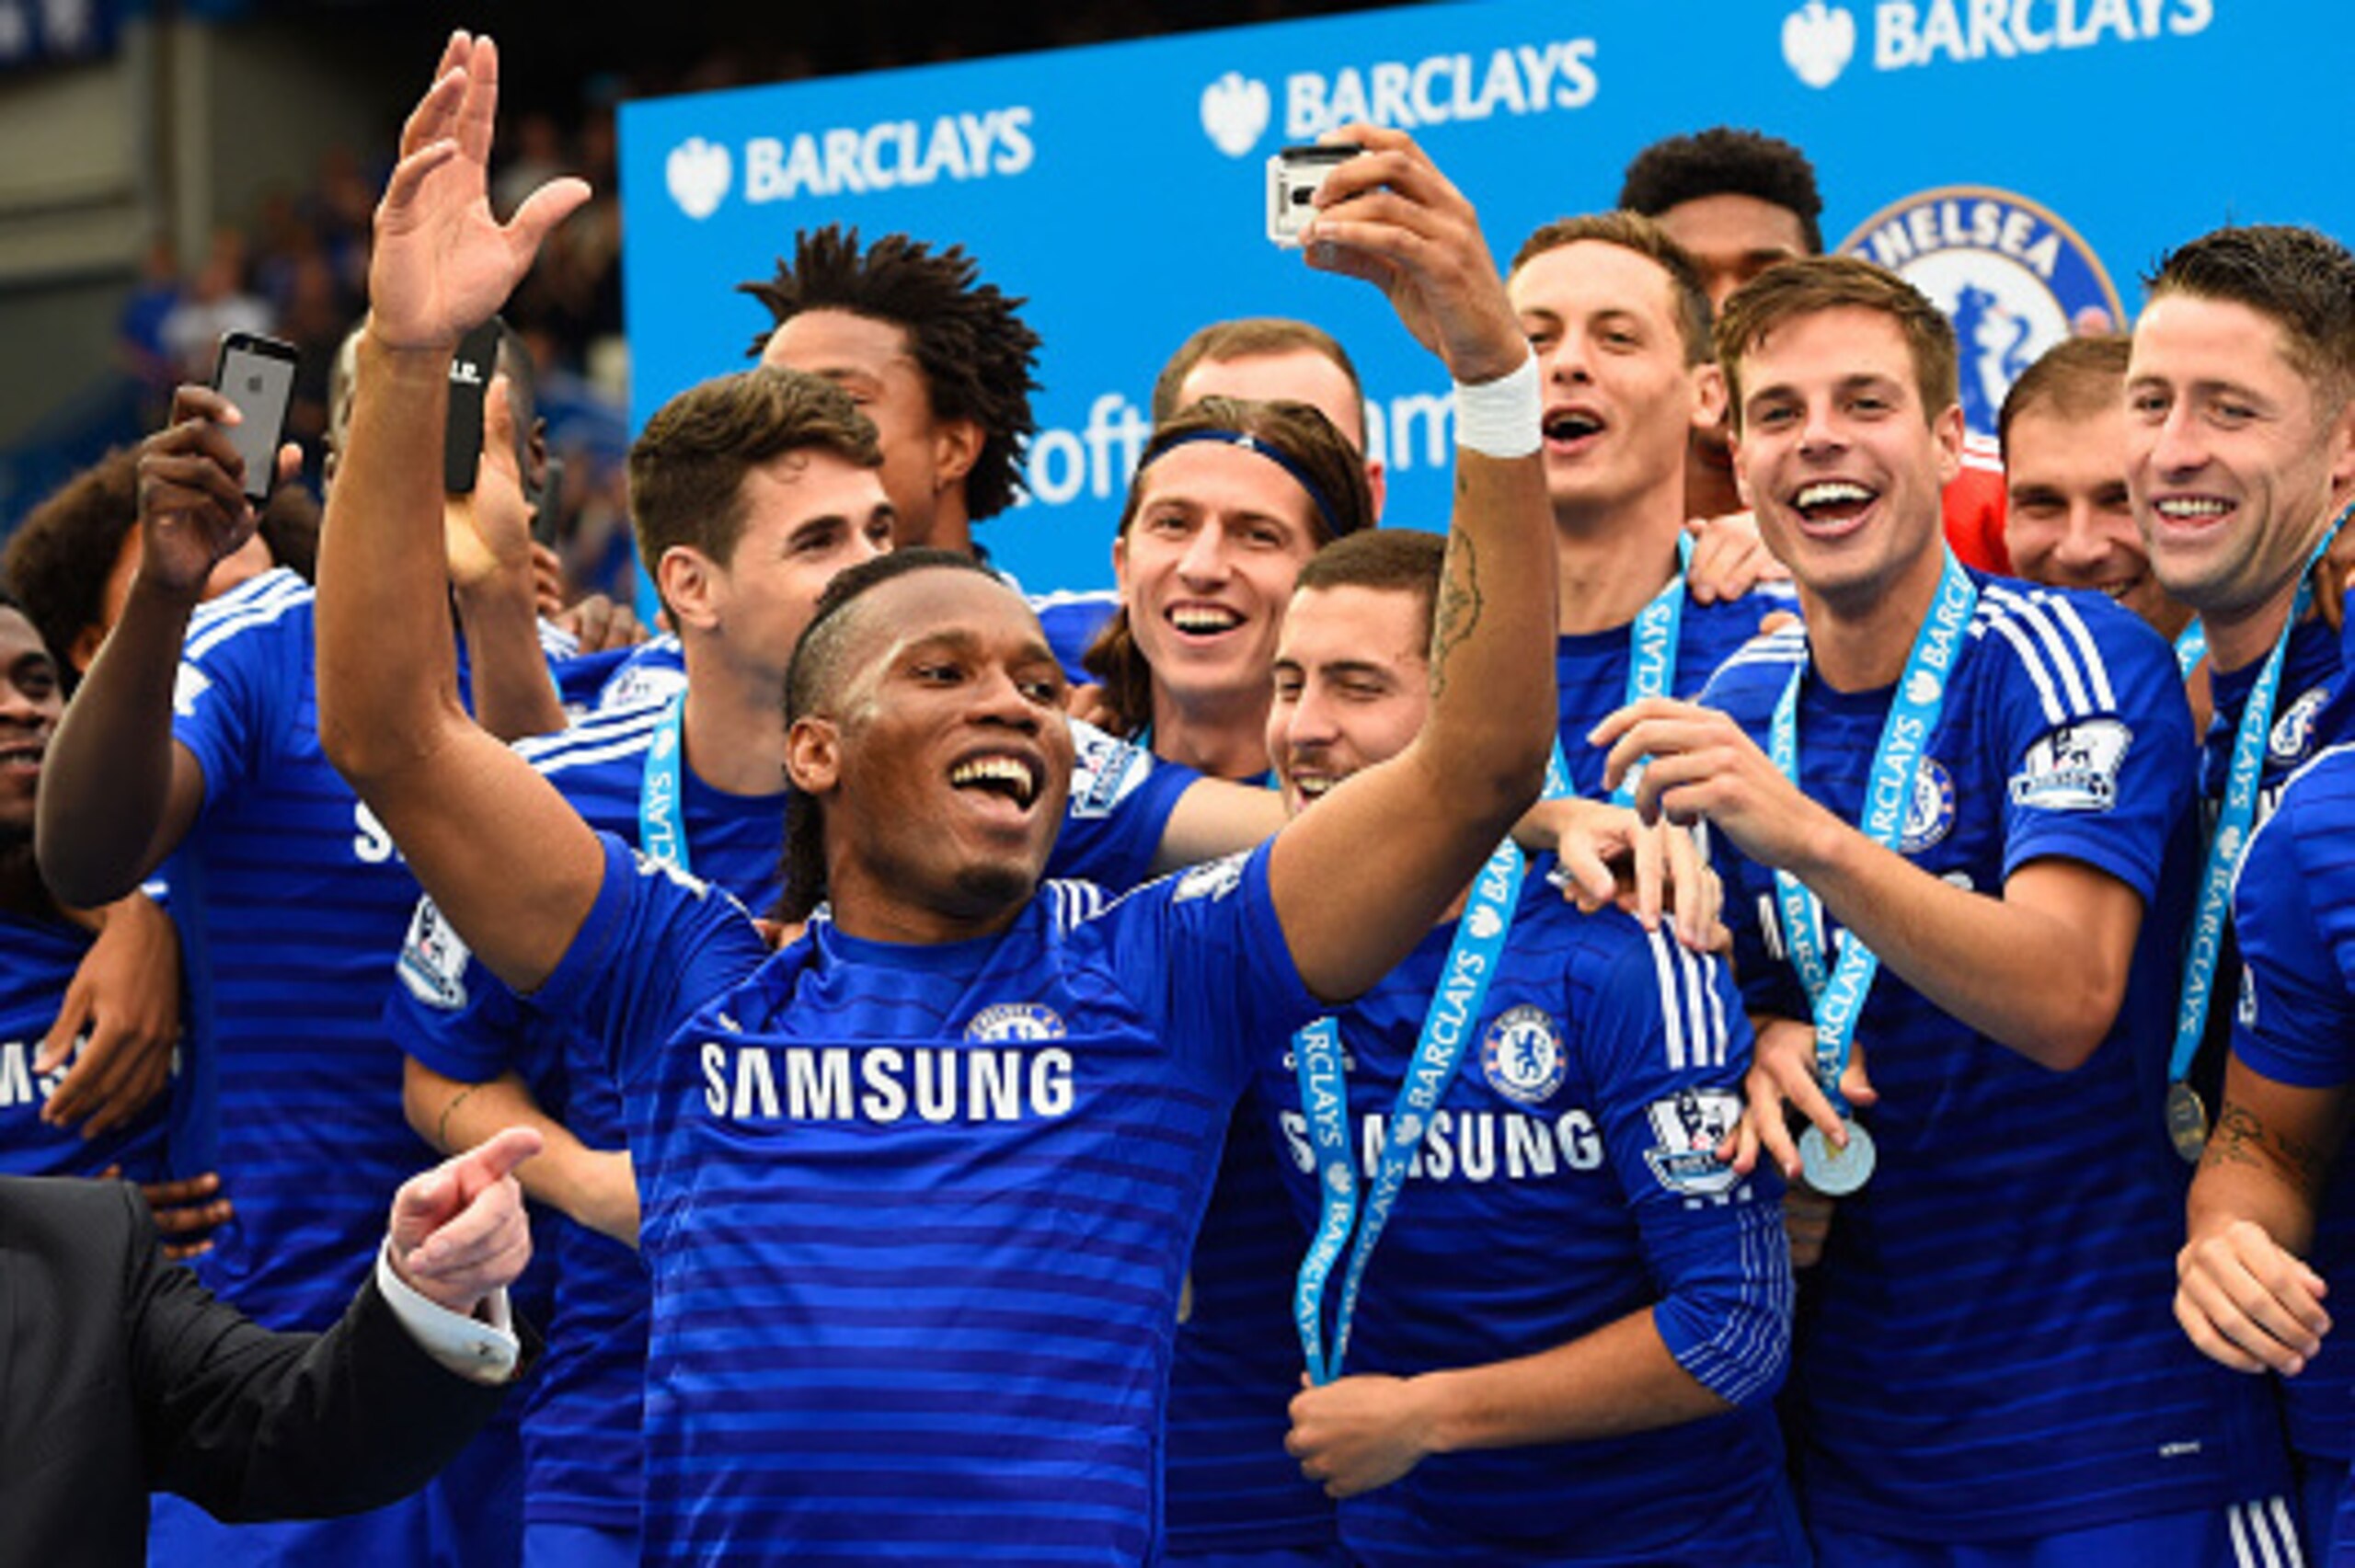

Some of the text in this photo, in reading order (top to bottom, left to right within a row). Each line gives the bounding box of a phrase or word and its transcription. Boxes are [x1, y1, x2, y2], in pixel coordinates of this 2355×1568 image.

[1284, 39, 1598, 139] BARCLAYS
[745, 107, 1034, 204] BARCLAYS
[1407, 950, 1485, 1110] BARCLAYS
[700, 1043, 1074, 1123] SAMSUNG
[1279, 1109, 1603, 1182] SMSUNG
